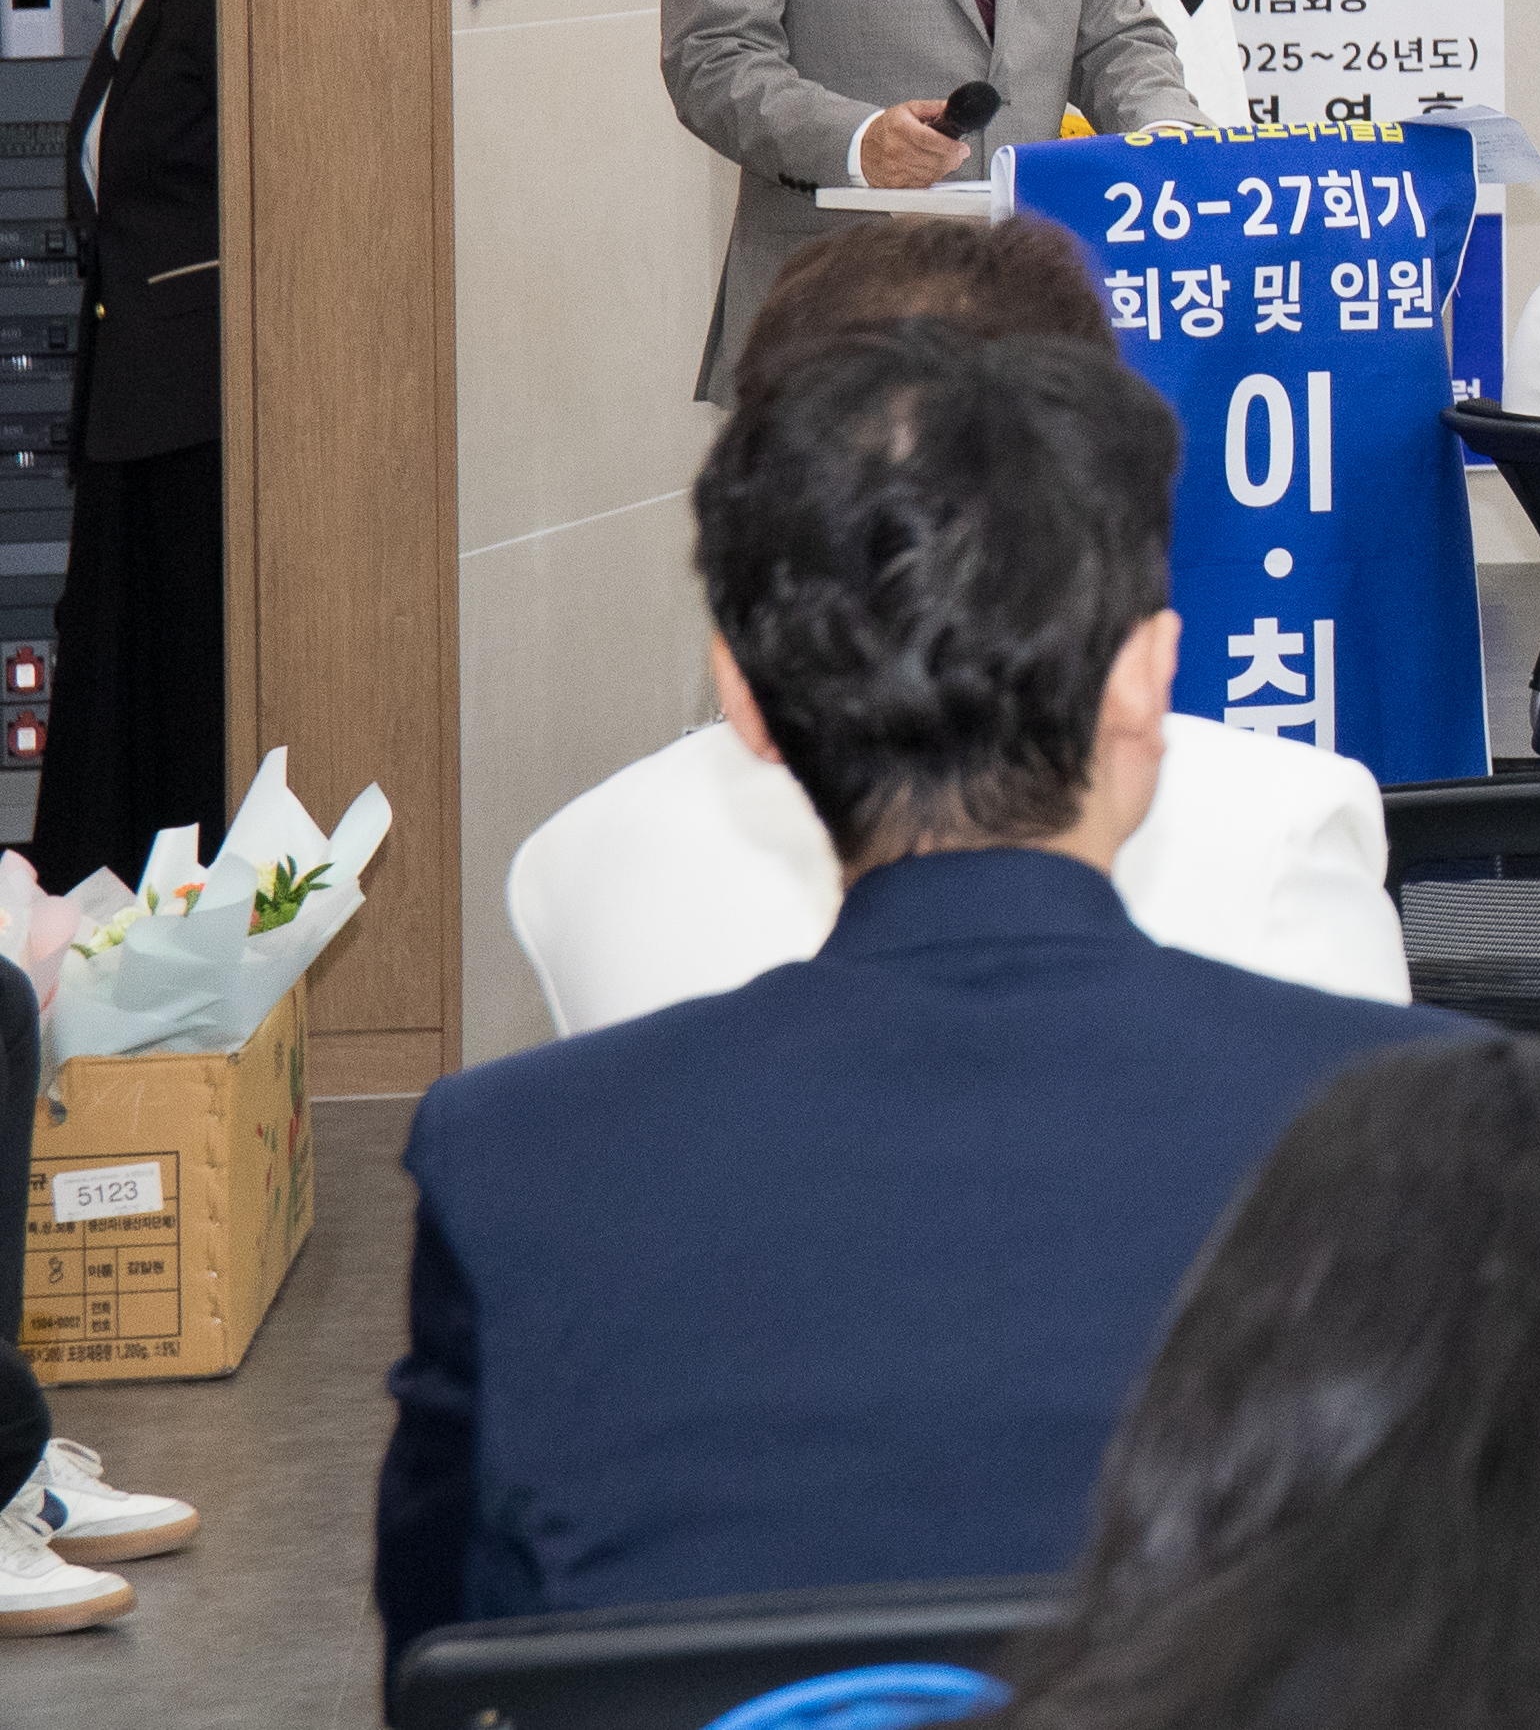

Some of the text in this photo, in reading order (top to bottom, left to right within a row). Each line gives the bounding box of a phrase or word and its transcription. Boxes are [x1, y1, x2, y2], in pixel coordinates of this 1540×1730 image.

[1104, 170, 1427, 243] 26-27회기
[1104, 257, 1434, 341] 회장 및 임원
[78, 1181, 138, 1206] 5123
